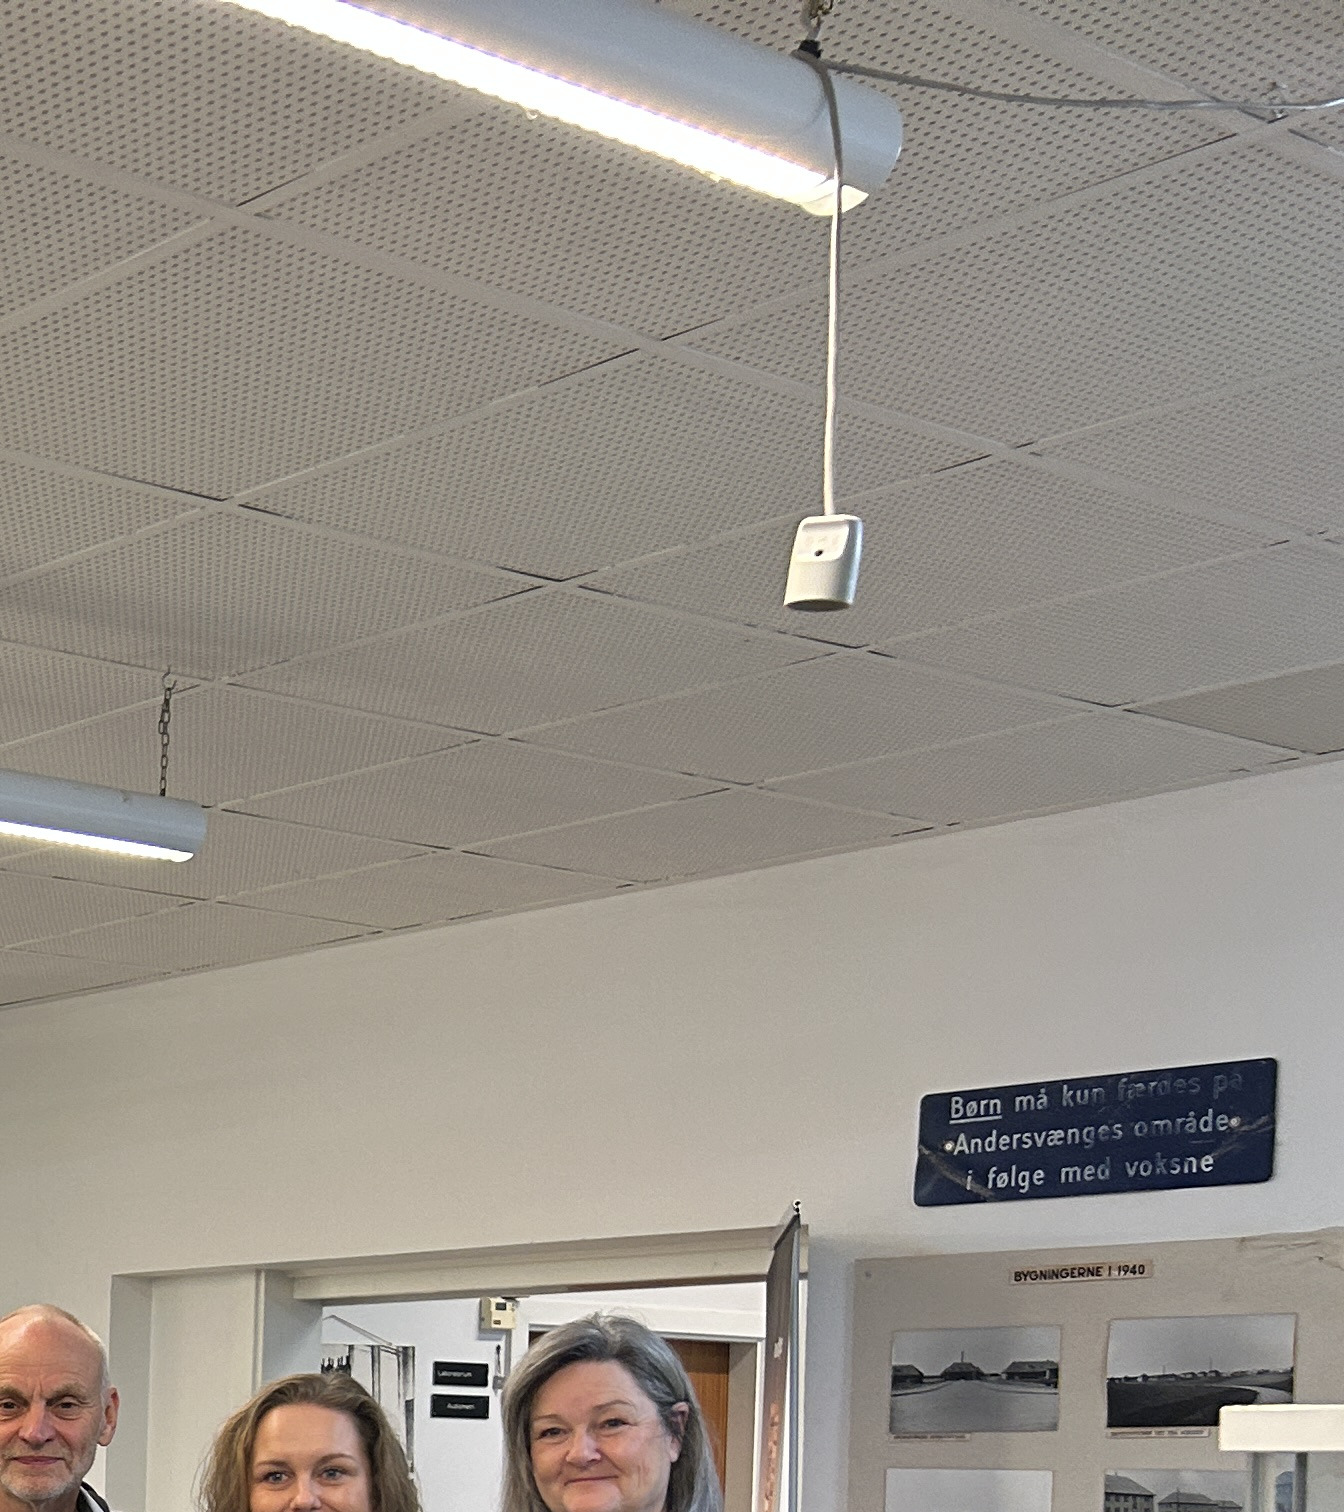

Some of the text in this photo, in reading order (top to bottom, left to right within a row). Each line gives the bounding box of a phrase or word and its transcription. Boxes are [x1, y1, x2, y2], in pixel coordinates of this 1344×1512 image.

[950, 1096, 1002, 1120] Børn
[1014, 1088, 1048, 1112] må
[1062, 1084, 1105, 1107] kun
[1117, 1074, 1201, 1101] færdes
[953, 1108, 1229, 1155] Andersvænges område
[966, 1152, 1214, 1193] i følge med voksne
[1013, 1266, 1104, 1282] BYGNINGERNE
[1117, 1264, 1146, 1277] 1940
